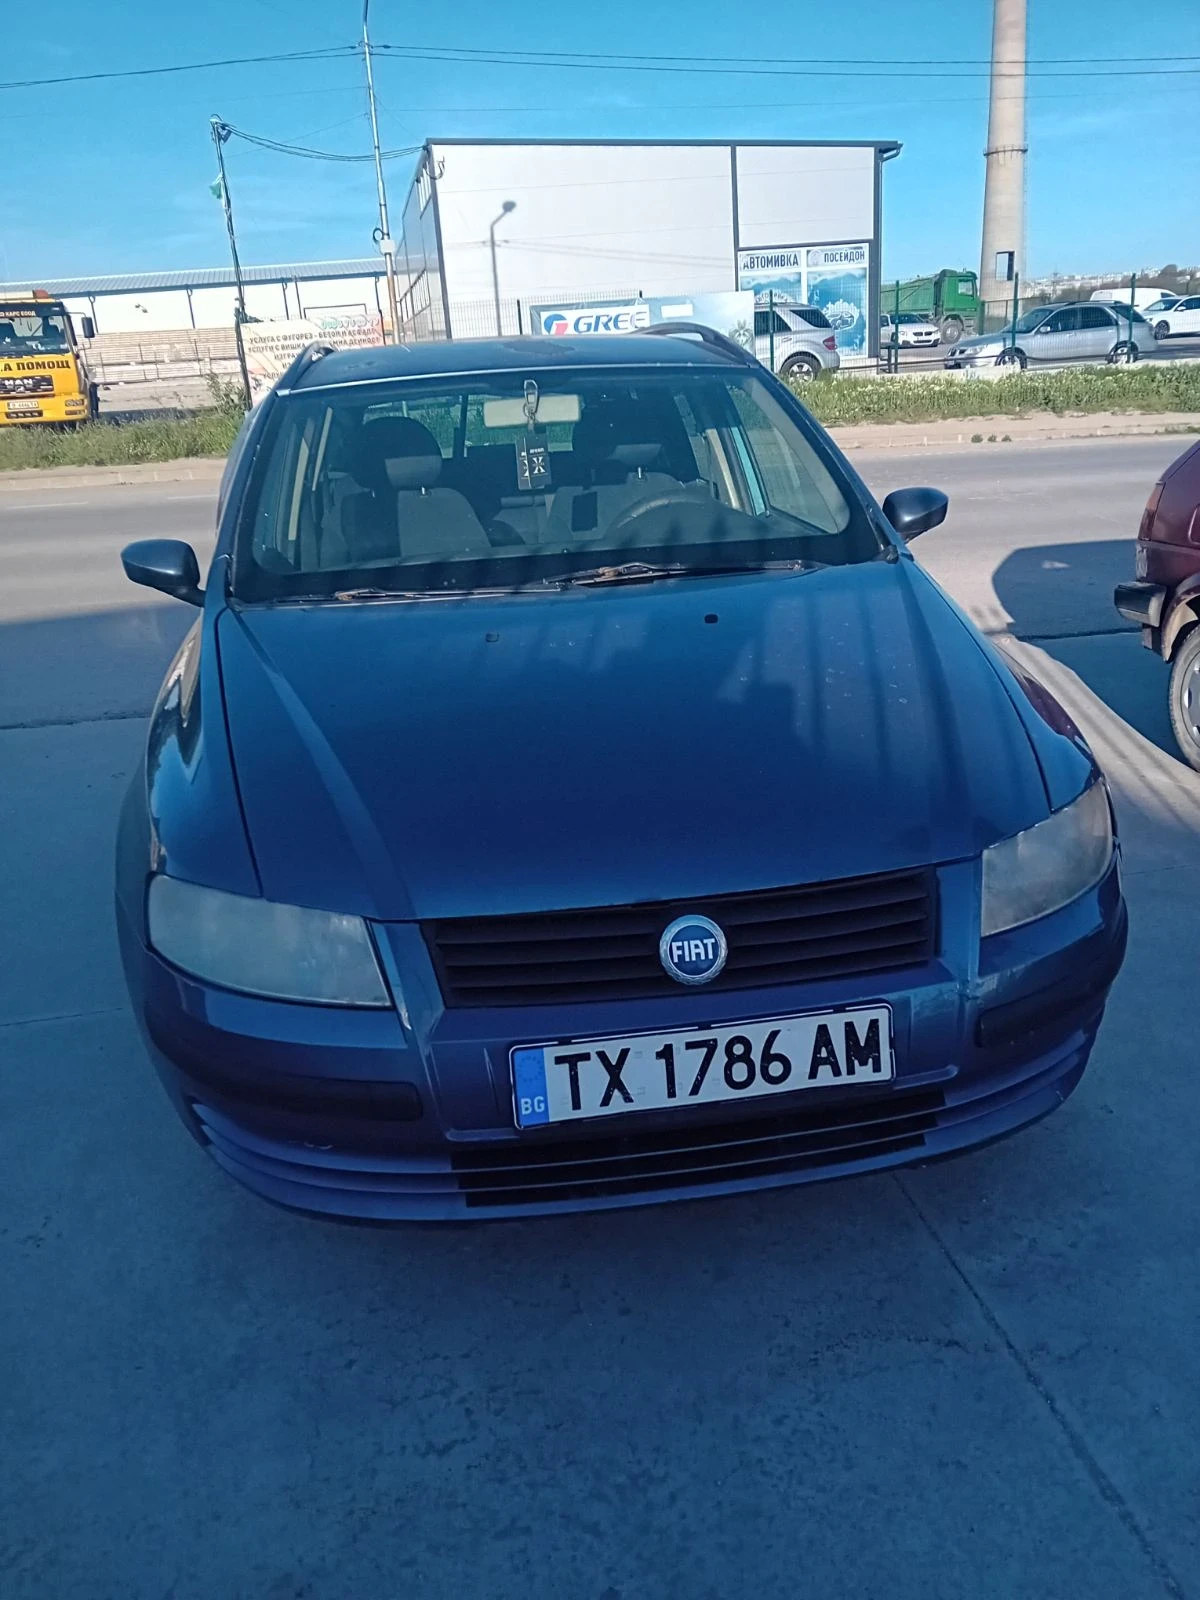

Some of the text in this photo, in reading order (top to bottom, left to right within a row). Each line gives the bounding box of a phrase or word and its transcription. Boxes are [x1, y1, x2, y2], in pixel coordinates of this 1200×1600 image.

[743, 254, 799, 270] АВТОМИВКА
[824, 249, 865, 263] ПОСЕЙДОН
[573, 311, 648, 334] GREE
[16, 360, 71, 371] ПОМОЩ
[4, 378, 33, 386] MAN
[671, 937, 716, 963] FIAT
[554, 1018, 882, 1111] TX 1786 AM
[520, 1096, 545, 1115] BG
